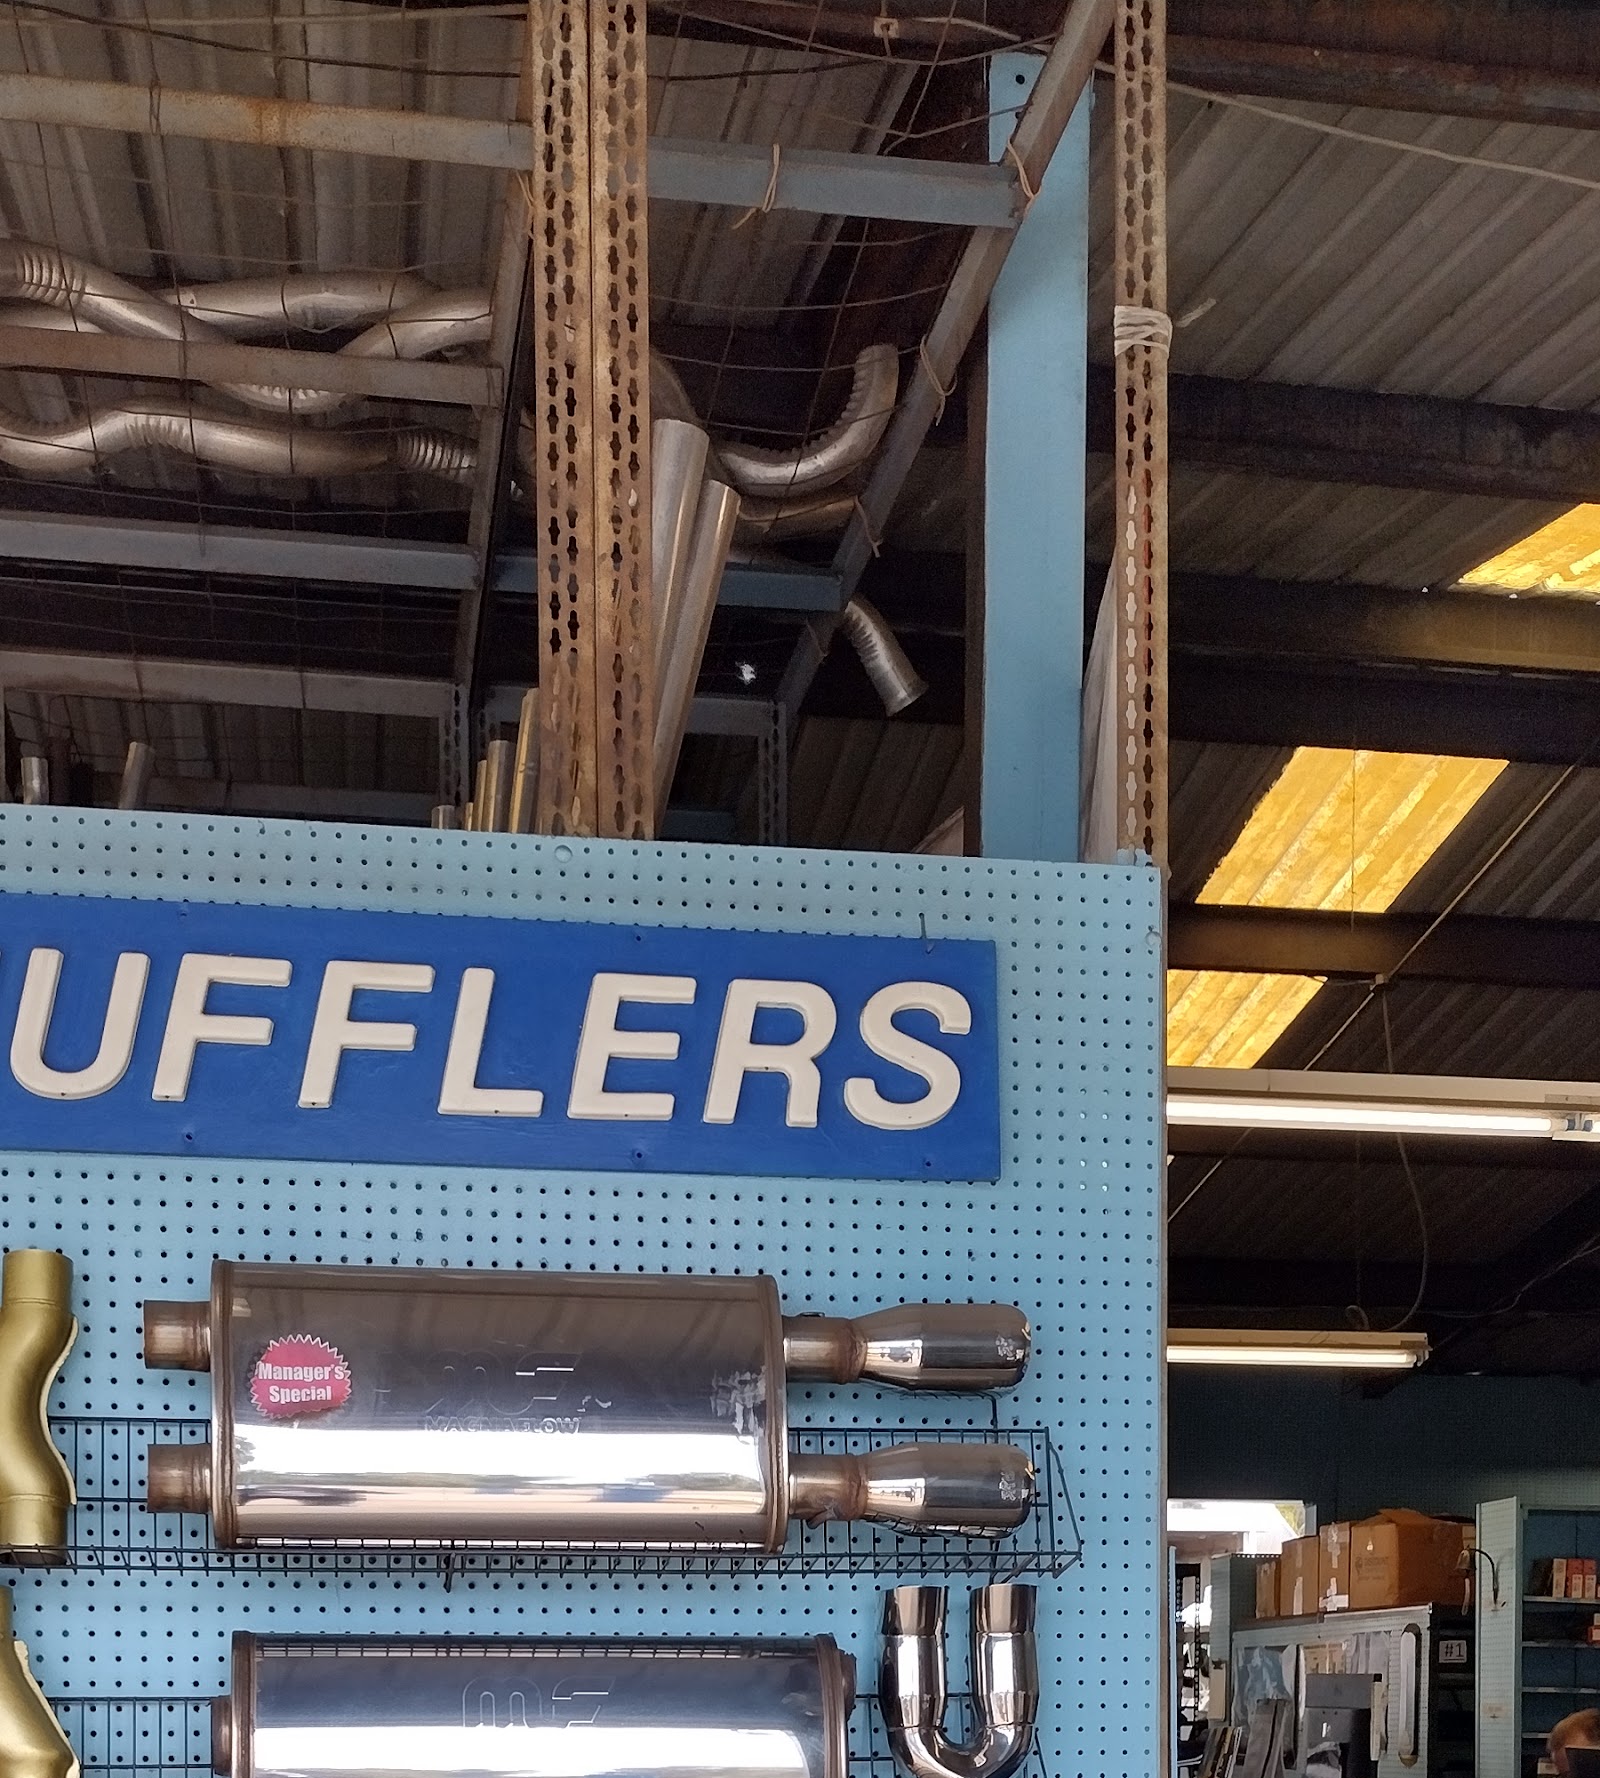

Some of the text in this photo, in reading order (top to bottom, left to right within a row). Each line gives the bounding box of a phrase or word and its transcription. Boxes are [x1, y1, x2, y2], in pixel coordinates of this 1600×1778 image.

[257, 1362, 345, 1383] Manager's
[269, 1385, 332, 1404] Special
[1444, 1642, 1465, 1658] #1
